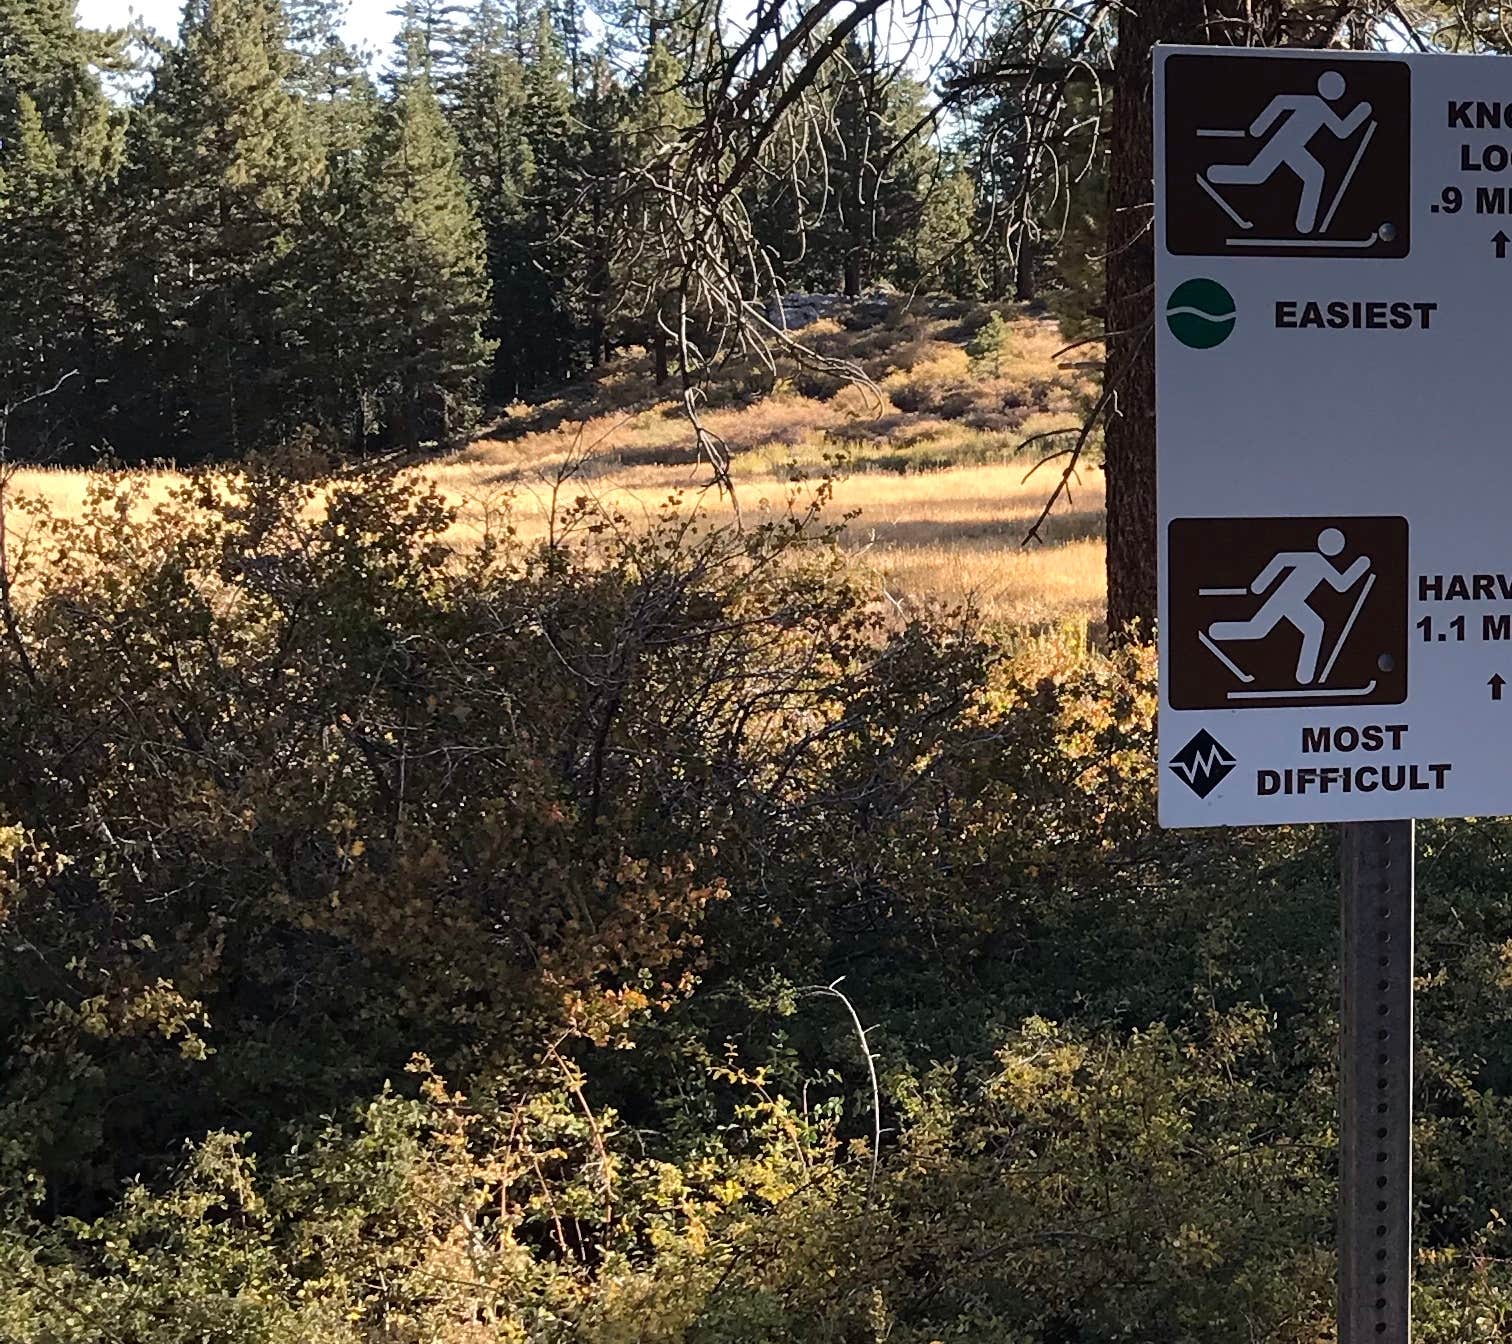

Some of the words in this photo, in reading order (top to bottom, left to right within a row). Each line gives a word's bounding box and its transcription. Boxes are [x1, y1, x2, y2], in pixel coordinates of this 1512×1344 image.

[1430, 186, 1463, 215] .9
[1275, 301, 1438, 330] EASIEST
[1416, 615, 1466, 642] 1.1
[1301, 724, 1409, 754] MOST
[1257, 763, 1452, 796] DIFFICULT
